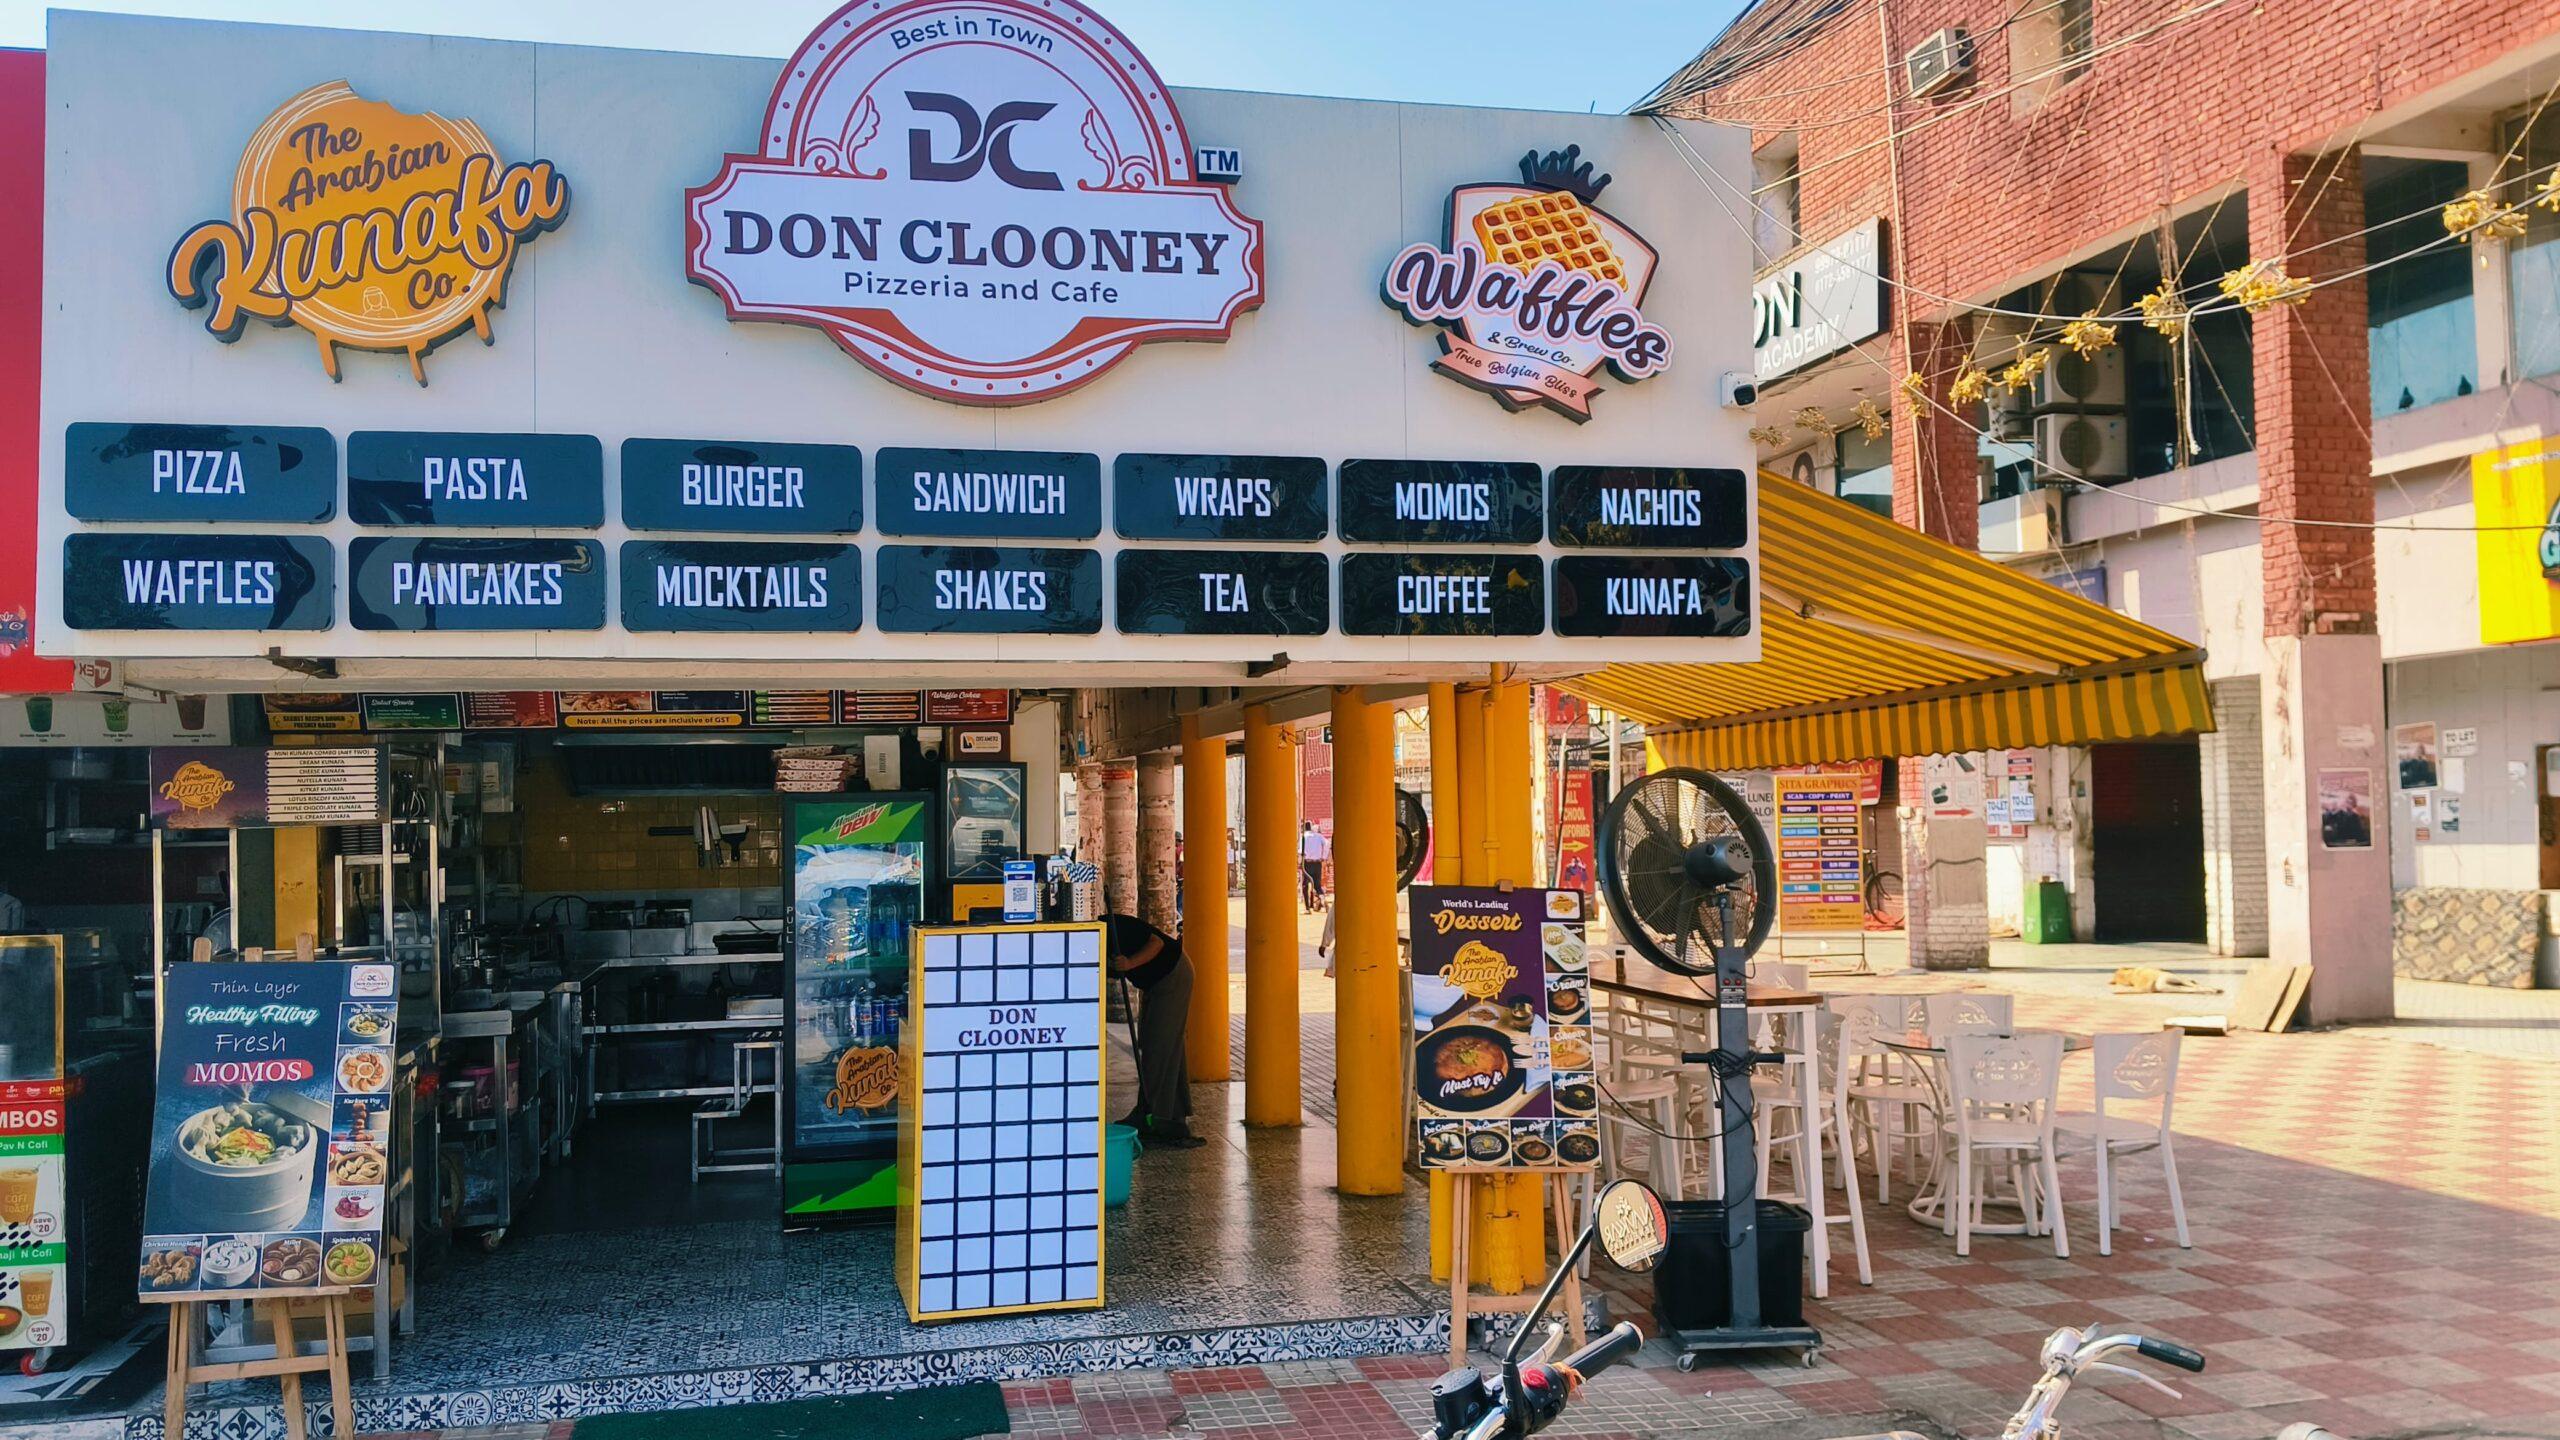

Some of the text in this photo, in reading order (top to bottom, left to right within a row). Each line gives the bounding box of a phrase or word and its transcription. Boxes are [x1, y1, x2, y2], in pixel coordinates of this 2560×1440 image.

[890, 16, 1055, 53] Best in Town
[288, 122, 363, 165] The
[904, 90, 1065, 192] DC
[1202, 150, 1240, 173] TM
[278, 137, 450, 213] Arabian
[168, 153, 567, 335] Kunafa
[723, 210, 1229, 276] DON CLOONEY
[406, 268, 472, 311] Co.
[844, 270, 1119, 304] Pizzeria and Cafe
[1396, 247, 1668, 369] Waffles
[1487, 331, 1575, 367] & Brew Co.
[1760, 315, 1839, 375] ACADEMY
[1455, 347, 1578, 399] True Belgian Bliss
[152, 449, 246, 495] PIZZA
[423, 456, 528, 501] PASTA
[681, 463, 804, 508] BURGER
[913, 471, 1066, 515] SANDWICH
[1174, 476, 1272, 518] WRAPS
[1394, 481, 1491, 522] MOMOS
[1600, 488, 1702, 527] NACHOS
[122, 559, 275, 605] WAFFLES
[391, 561, 563, 606] PANCAKES
[656, 564, 828, 609] MOCKTAILS
[934, 568, 1047, 612] SHAKES
[1200, 573, 1249, 613] TEA
[1396, 575, 1491, 615] COFFEE
[1606, 577, 1702, 616] KUNAFA
[159, 779, 236, 800] Kunafa
[1430, 909, 1522, 935] Dessert
[1441, 899, 1509, 911] World's Leading
[211, 980, 301, 1000] Thin Layer
[1438, 960, 1519, 988] Kunafa
[187, 1004, 319, 1027] Healthy Filling
[989, 1008, 1037, 1025] DON
[215, 1030, 287, 1053] Fresh
[958, 1026, 1068, 1047] CLOONEY
[192, 1061, 303, 1084] MOMOS
